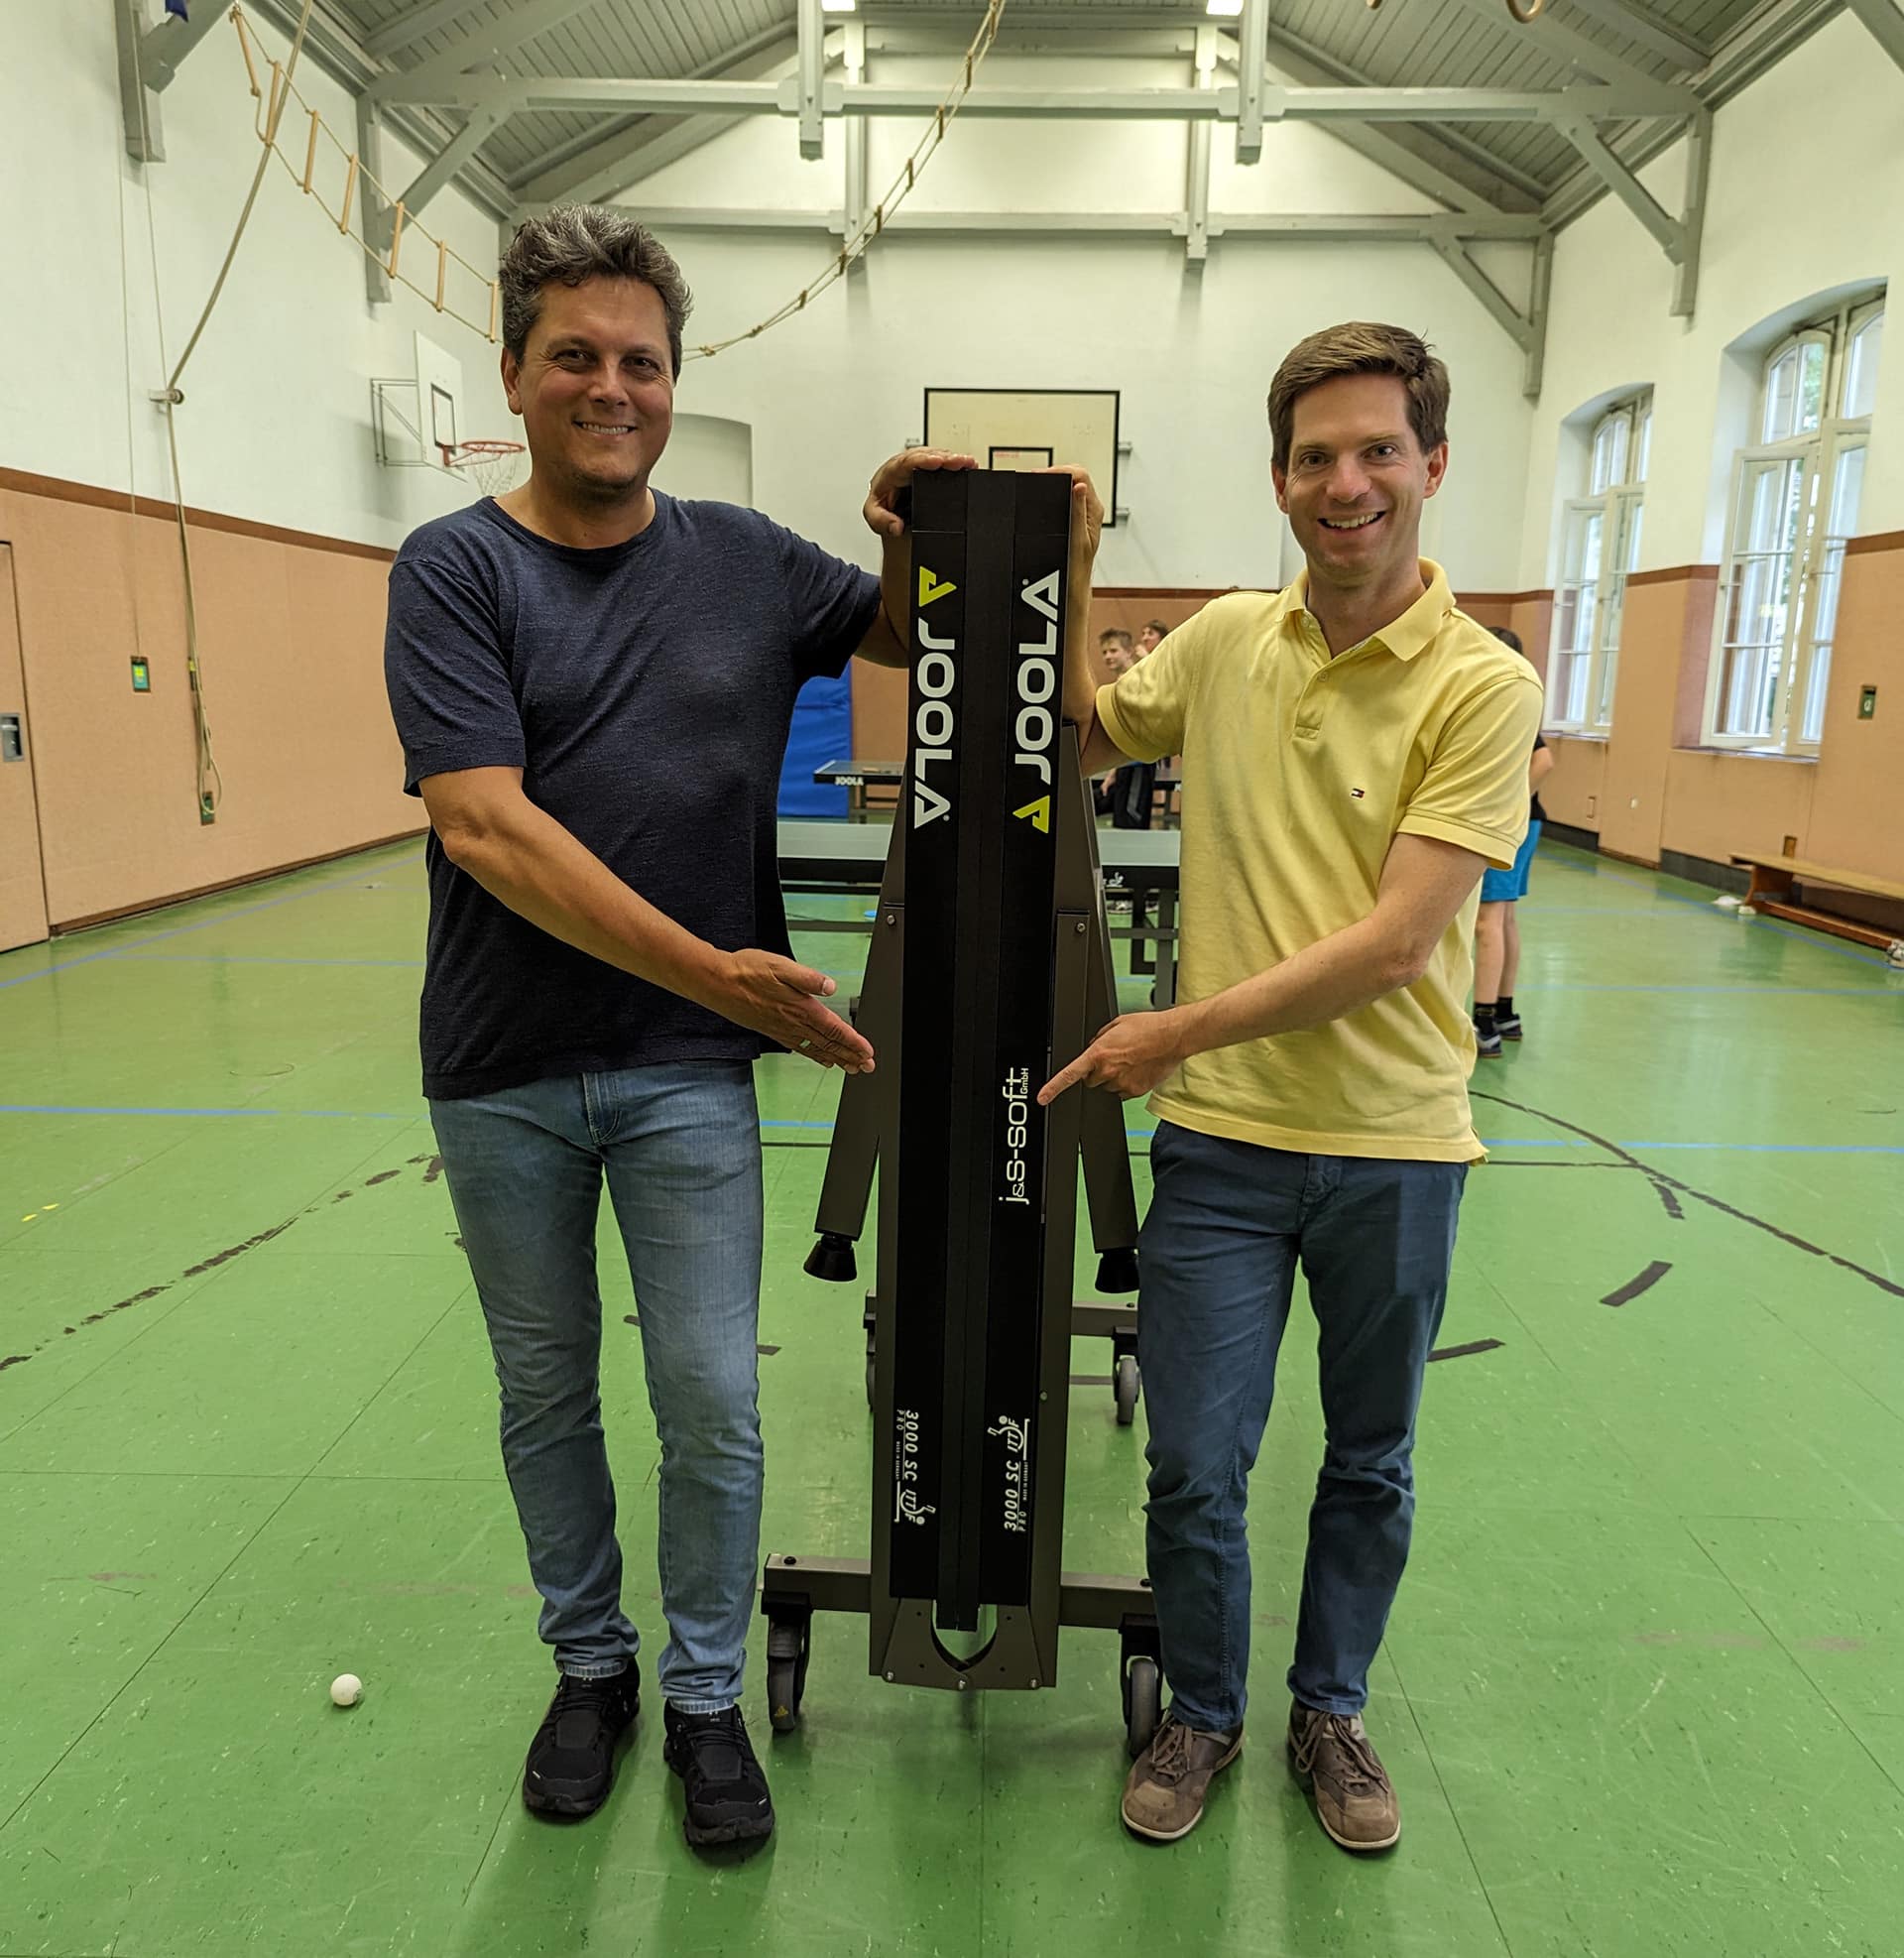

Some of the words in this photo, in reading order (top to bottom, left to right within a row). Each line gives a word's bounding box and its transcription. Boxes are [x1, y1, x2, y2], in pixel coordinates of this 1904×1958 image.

[1014, 569, 1060, 785] JOOLA
[914, 617, 956, 829] JOOLA
[999, 1067, 1030, 1205] j&s-soft
[1019, 1067, 1029, 1094] GmbH
[896, 1408, 905, 1430] PRO
[904, 1409, 919, 1453] 3000
[904, 1459, 917, 1482] SC
[1006, 1459, 1019, 1482] SC
[1004, 1488, 1018, 1531] 3000
[1017, 1511, 1027, 1531] PRO
